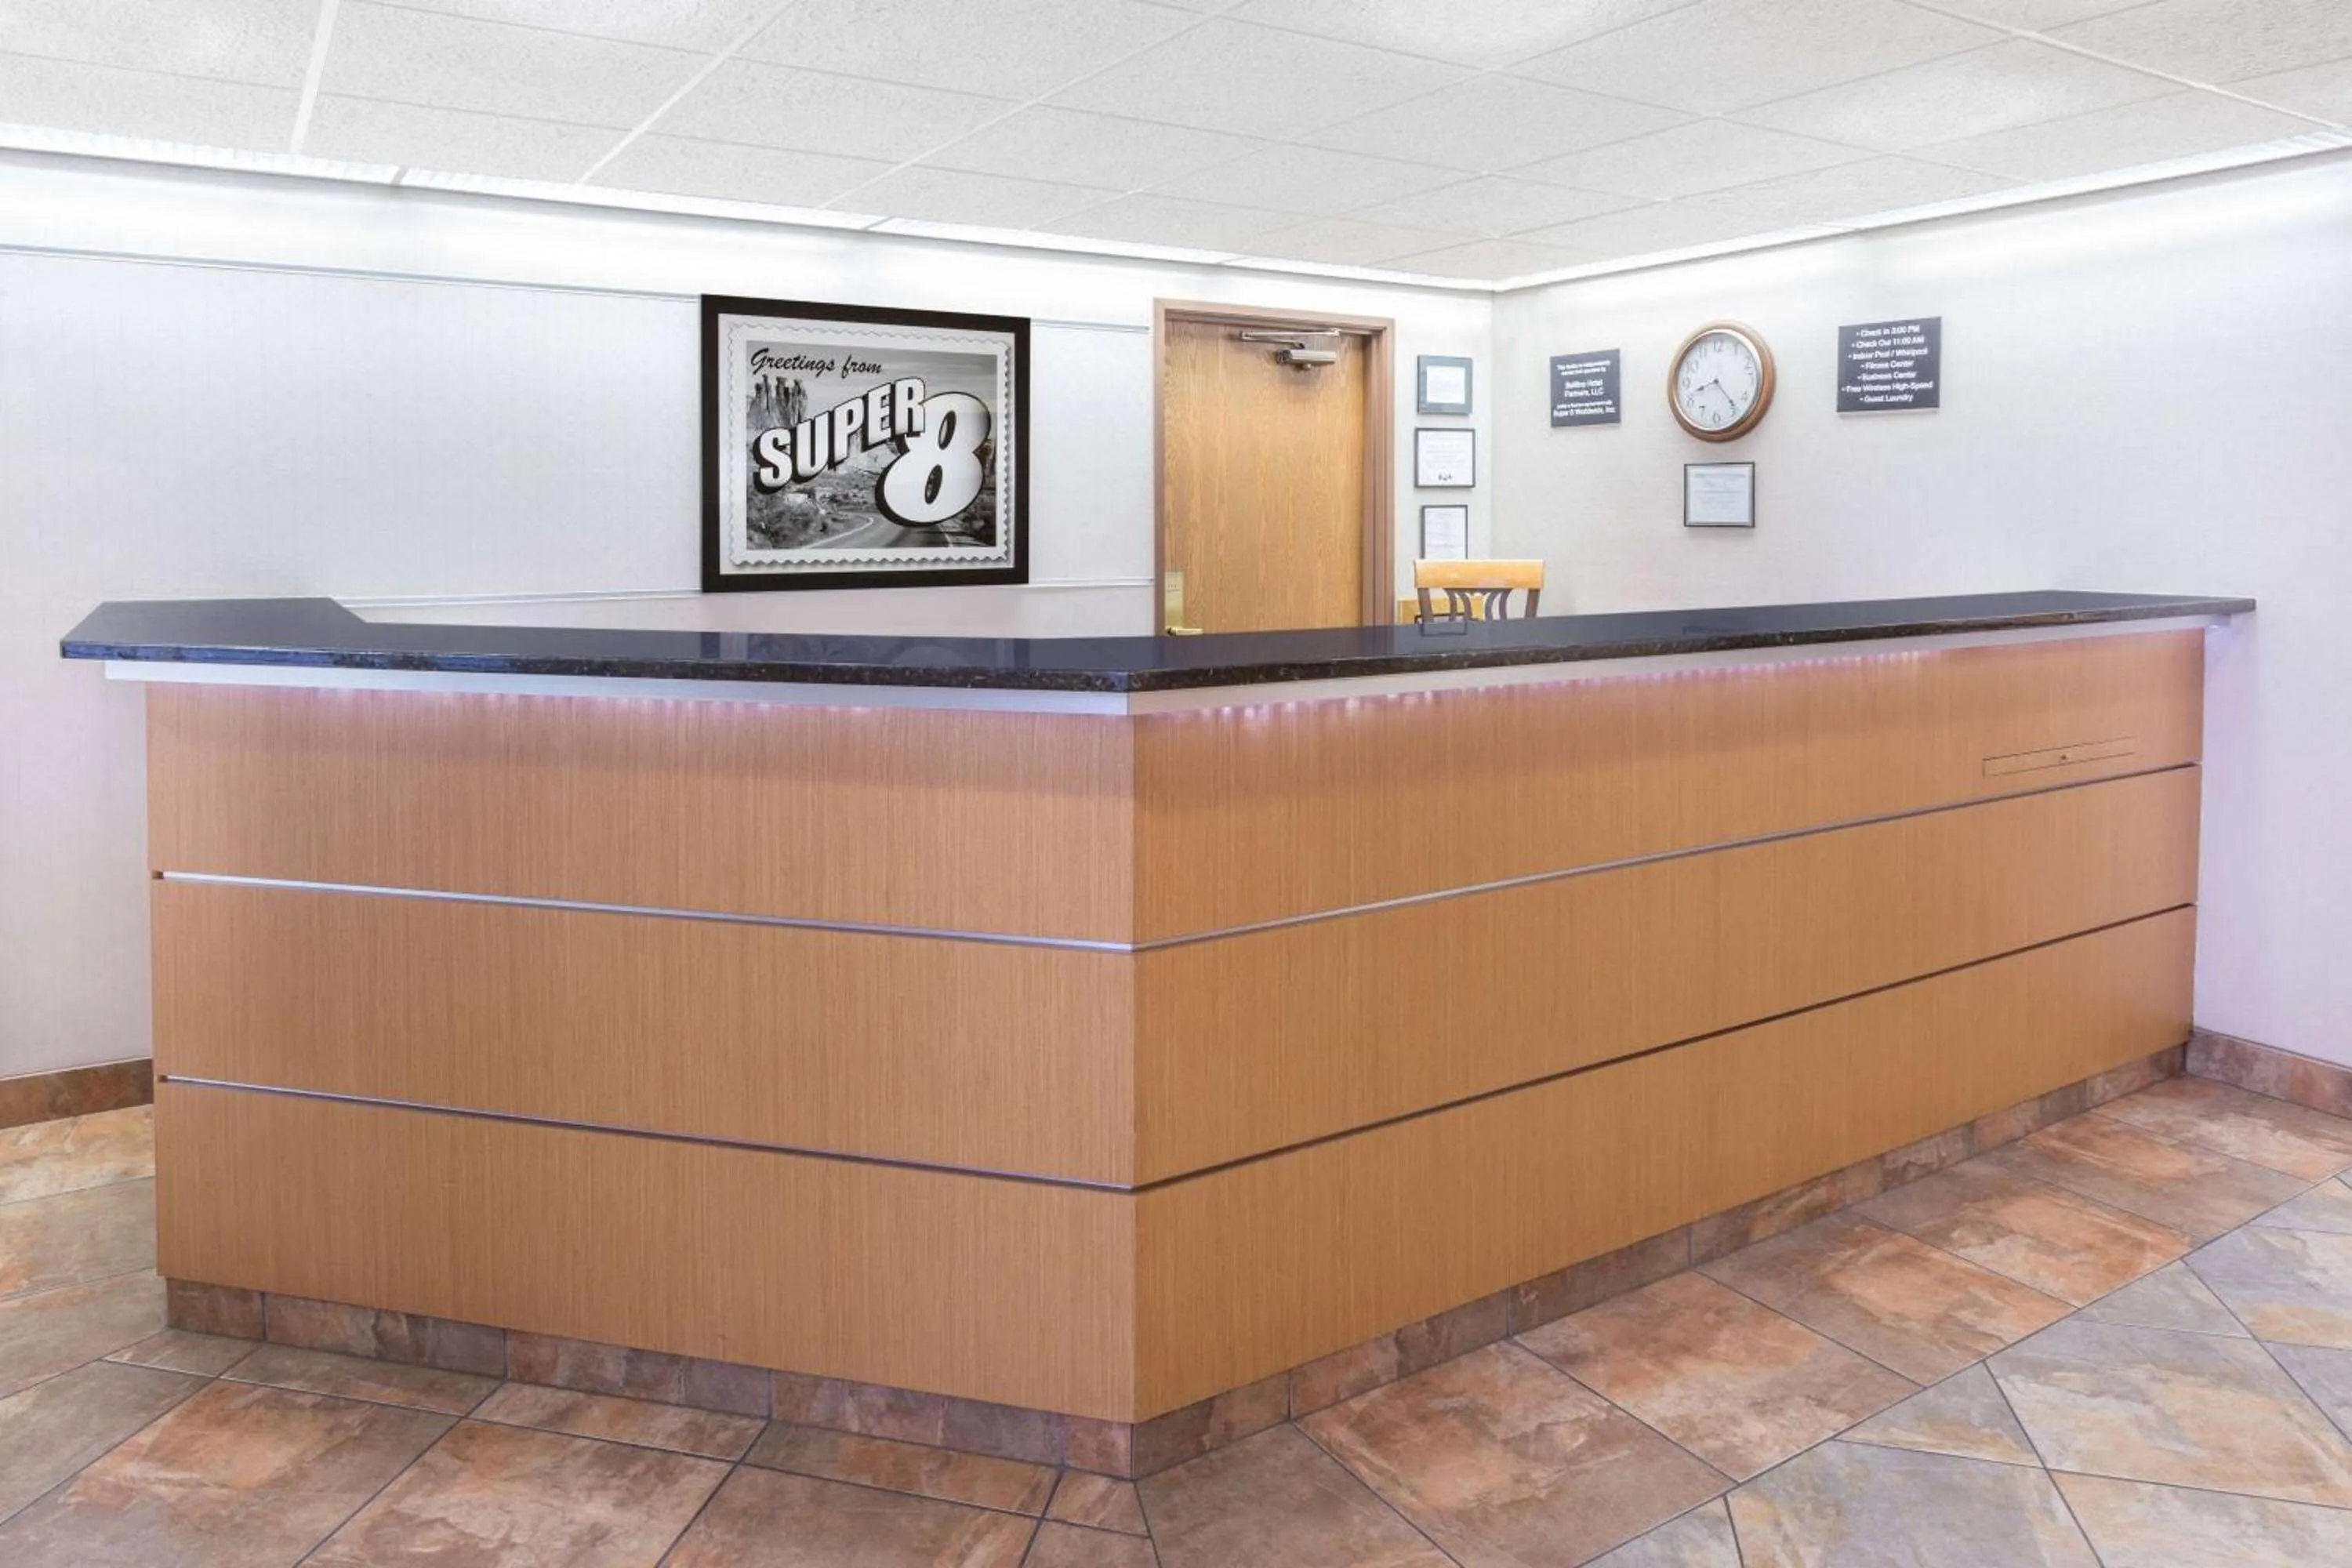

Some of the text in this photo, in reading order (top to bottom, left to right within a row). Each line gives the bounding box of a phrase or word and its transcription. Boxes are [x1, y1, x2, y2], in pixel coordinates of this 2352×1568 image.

[1713, 339, 1724, 353] 12
[1856, 339, 1877, 348] Check
[750, 347, 883, 379] Greetings from
[752, 376, 992, 527] SUPER 8
